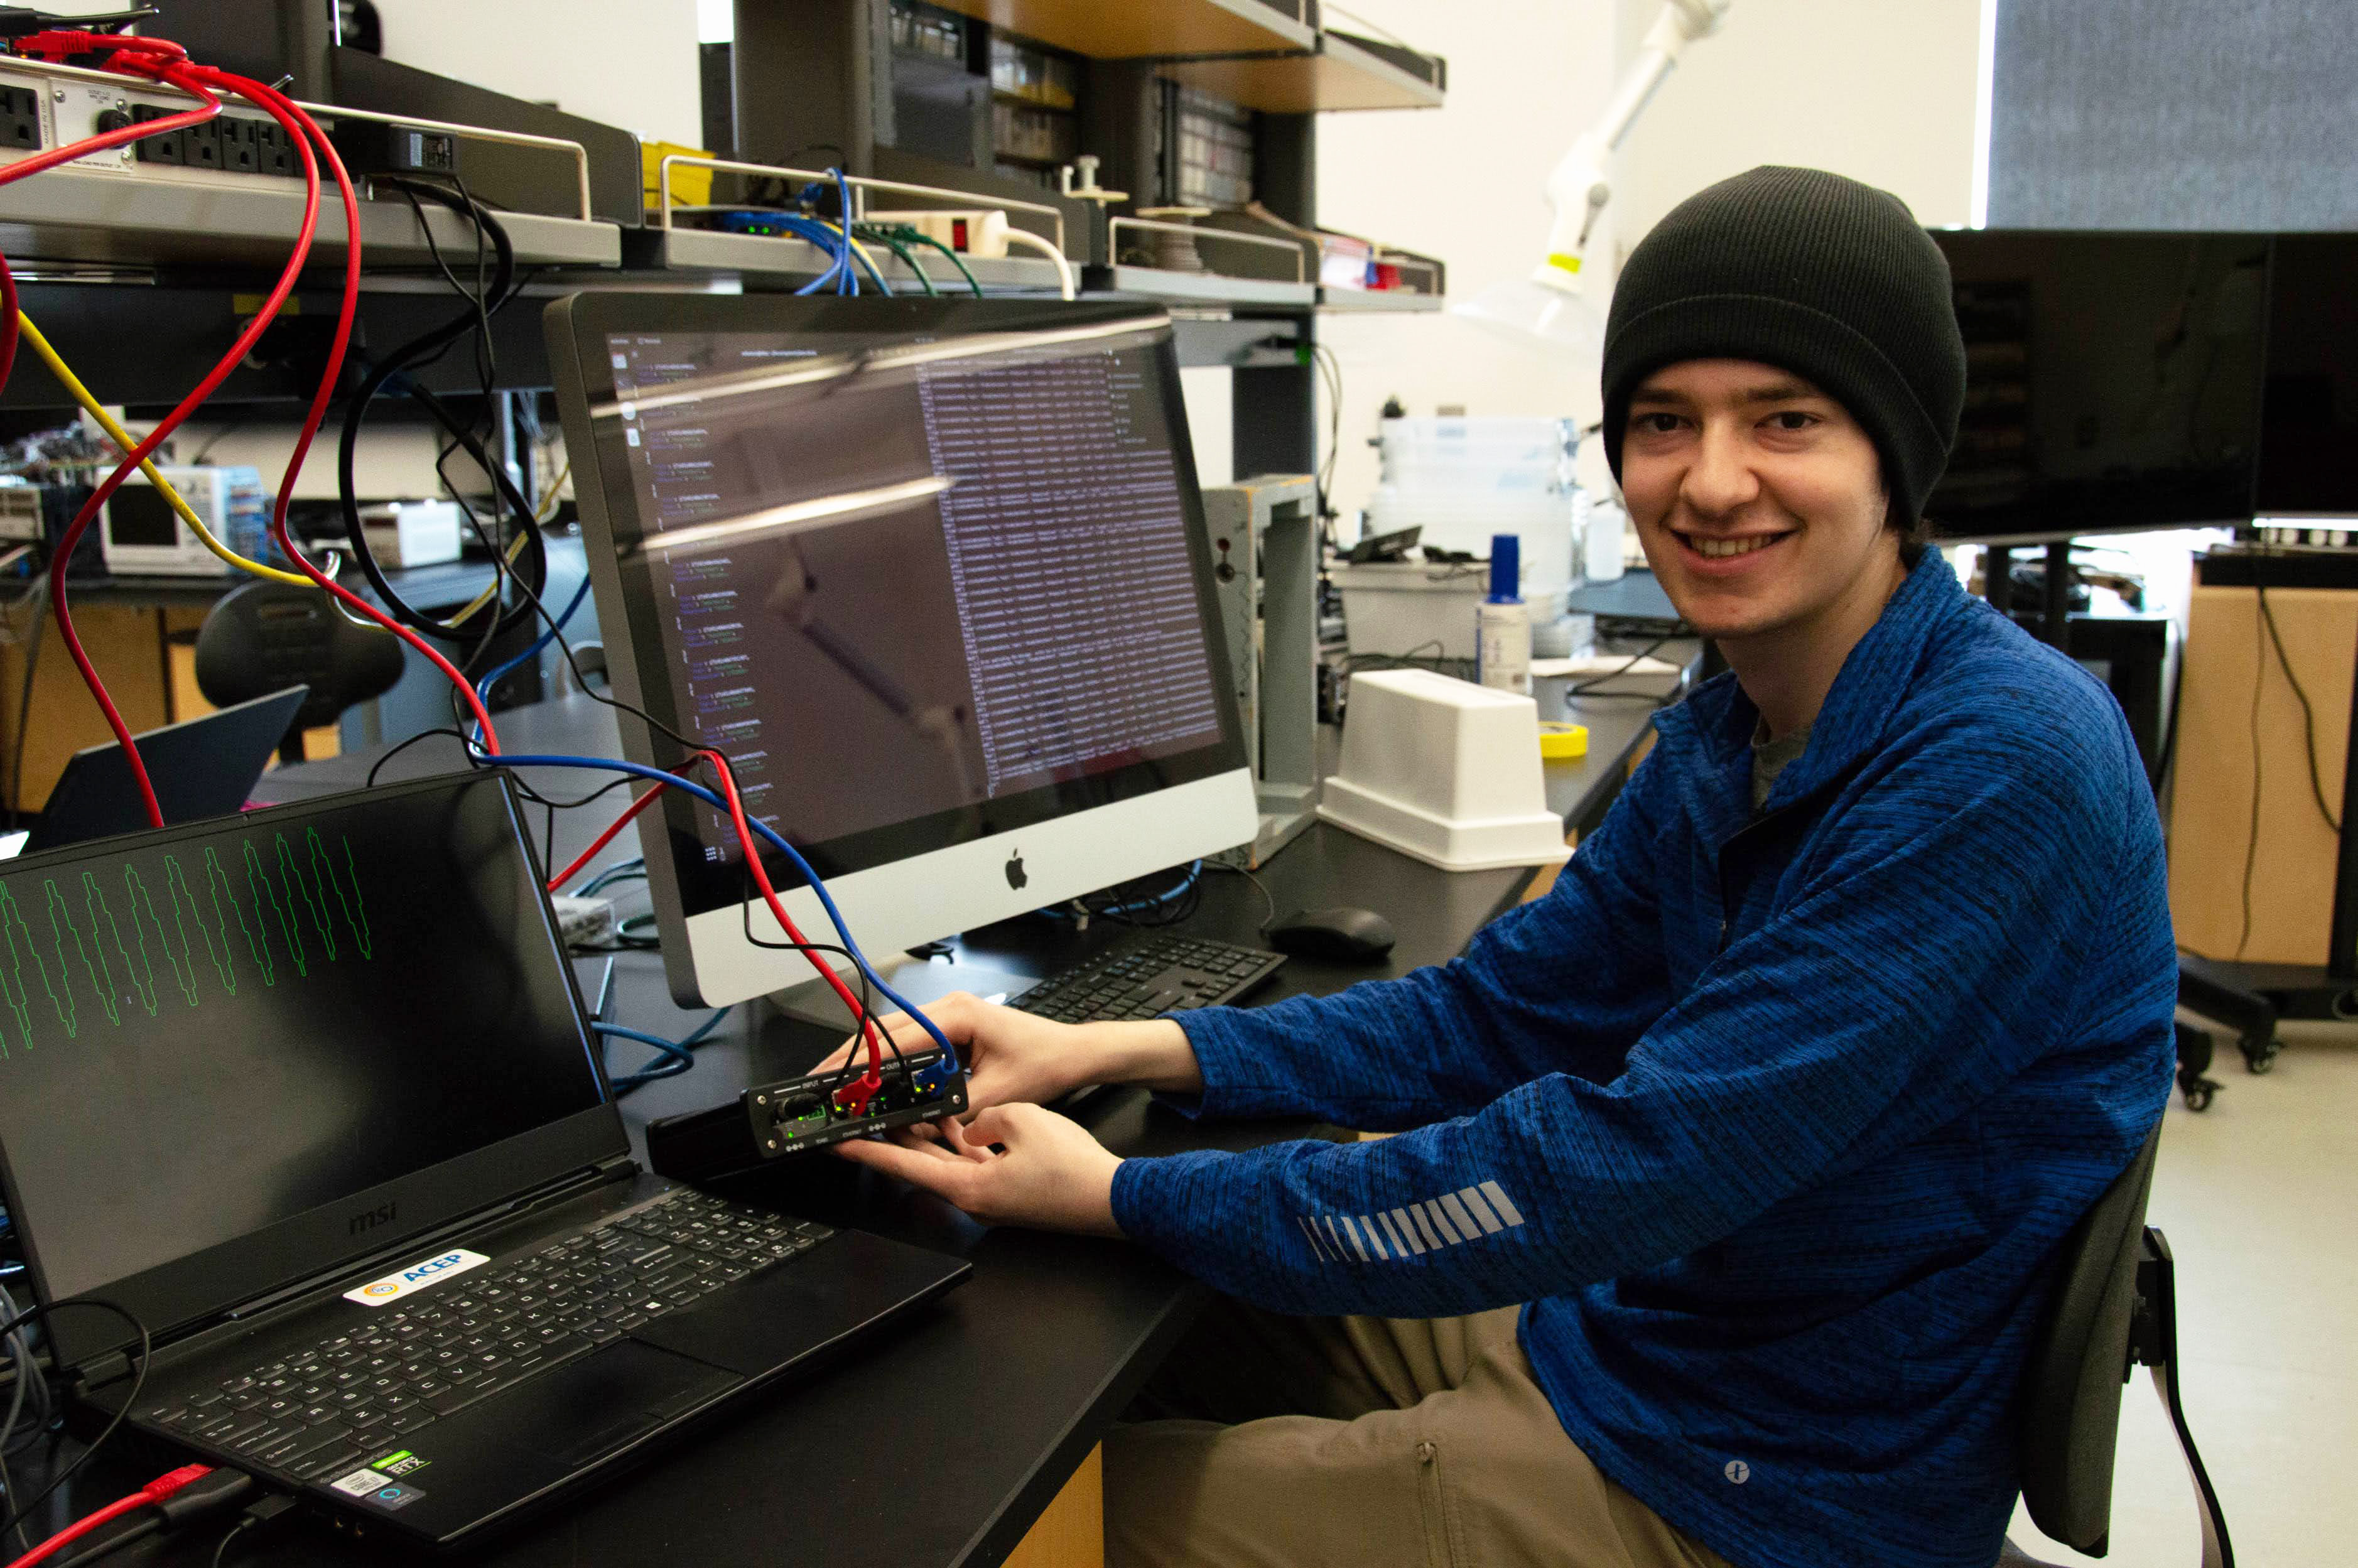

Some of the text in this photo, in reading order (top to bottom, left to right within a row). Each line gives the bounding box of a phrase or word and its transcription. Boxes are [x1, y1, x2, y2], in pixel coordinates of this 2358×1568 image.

[349, 1202, 396, 1235] msi
[403, 1254, 463, 1282] ACEP
[391, 1460, 425, 1475] RTX
